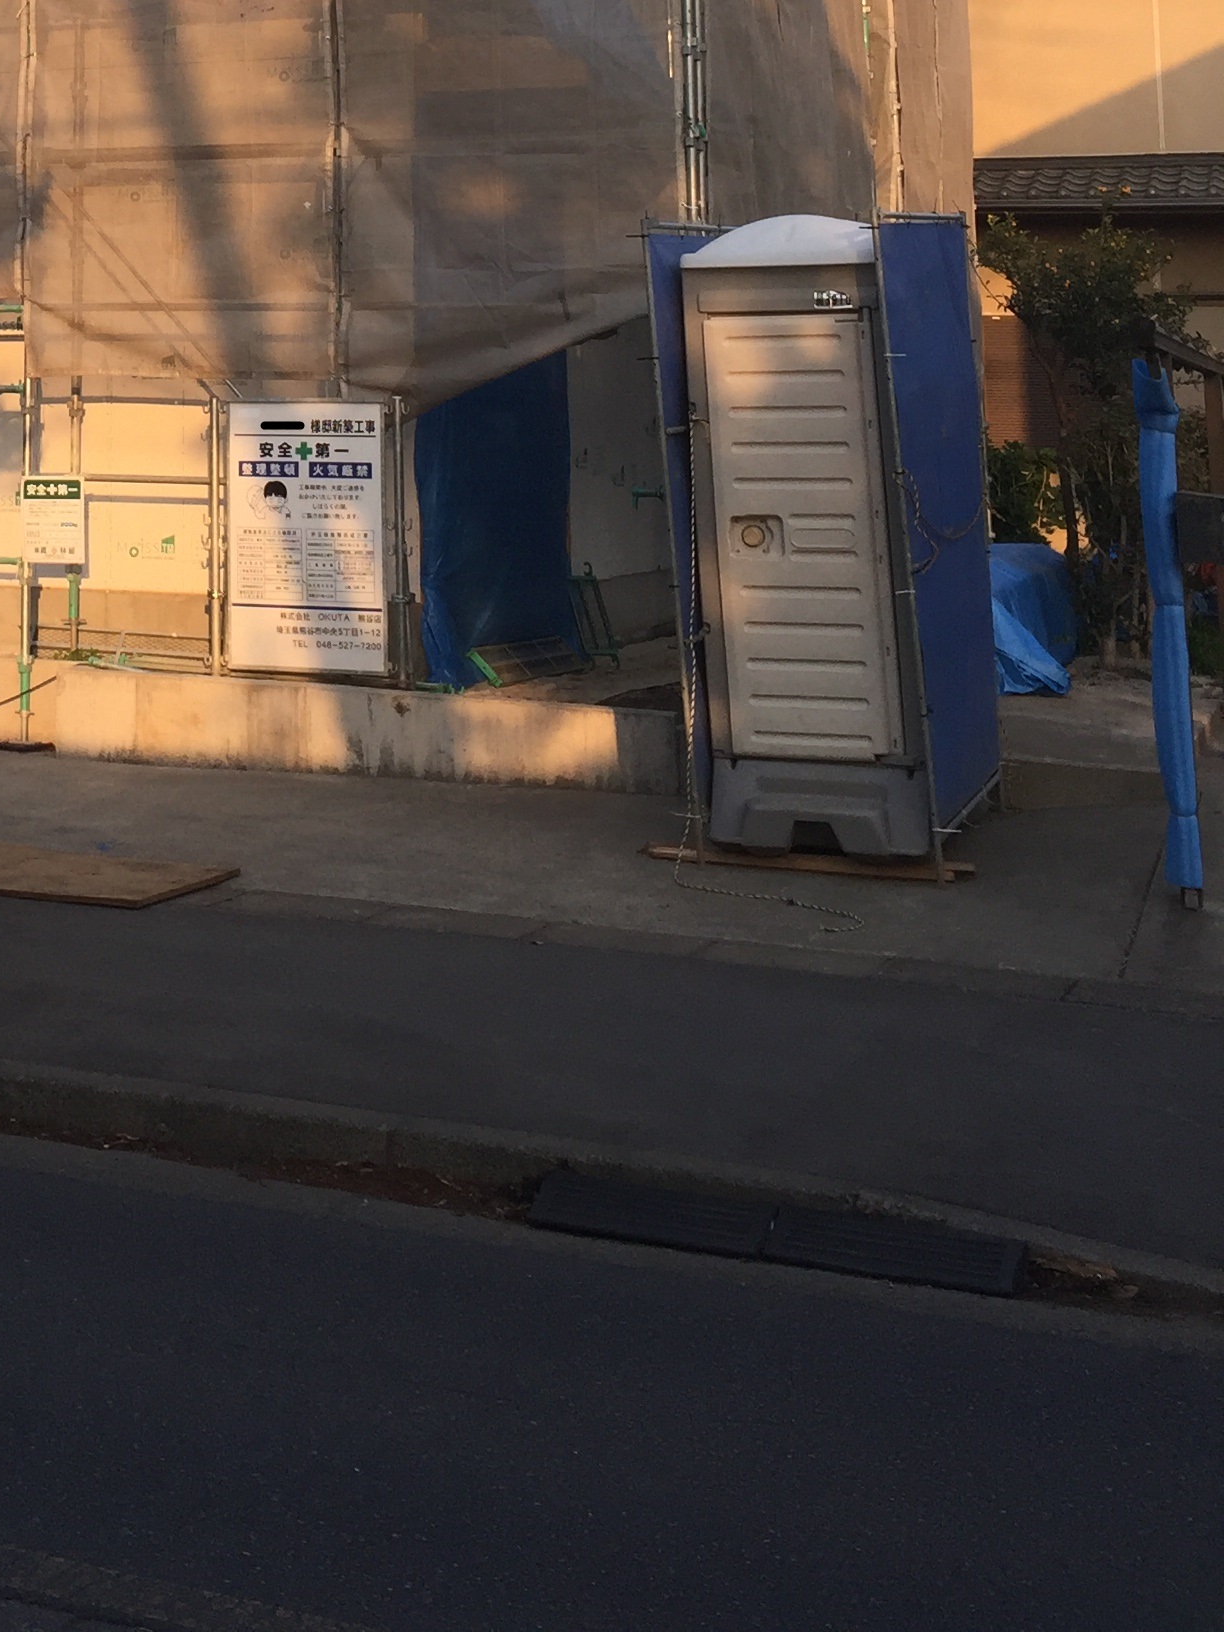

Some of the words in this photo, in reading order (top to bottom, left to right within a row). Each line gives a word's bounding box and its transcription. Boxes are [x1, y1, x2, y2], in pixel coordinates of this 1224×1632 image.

[259, 441, 293, 458] 安全
[314, 442, 349, 458] 第一
[241, 463, 296, 476] 整理整頓
[312, 464, 369, 478] 火気厳禁
[26, 484, 46, 496] 安全
[57, 484, 78, 496] 第一
[317, 613, 350, 622] OKUTA
[292, 639, 308, 648] TEL
